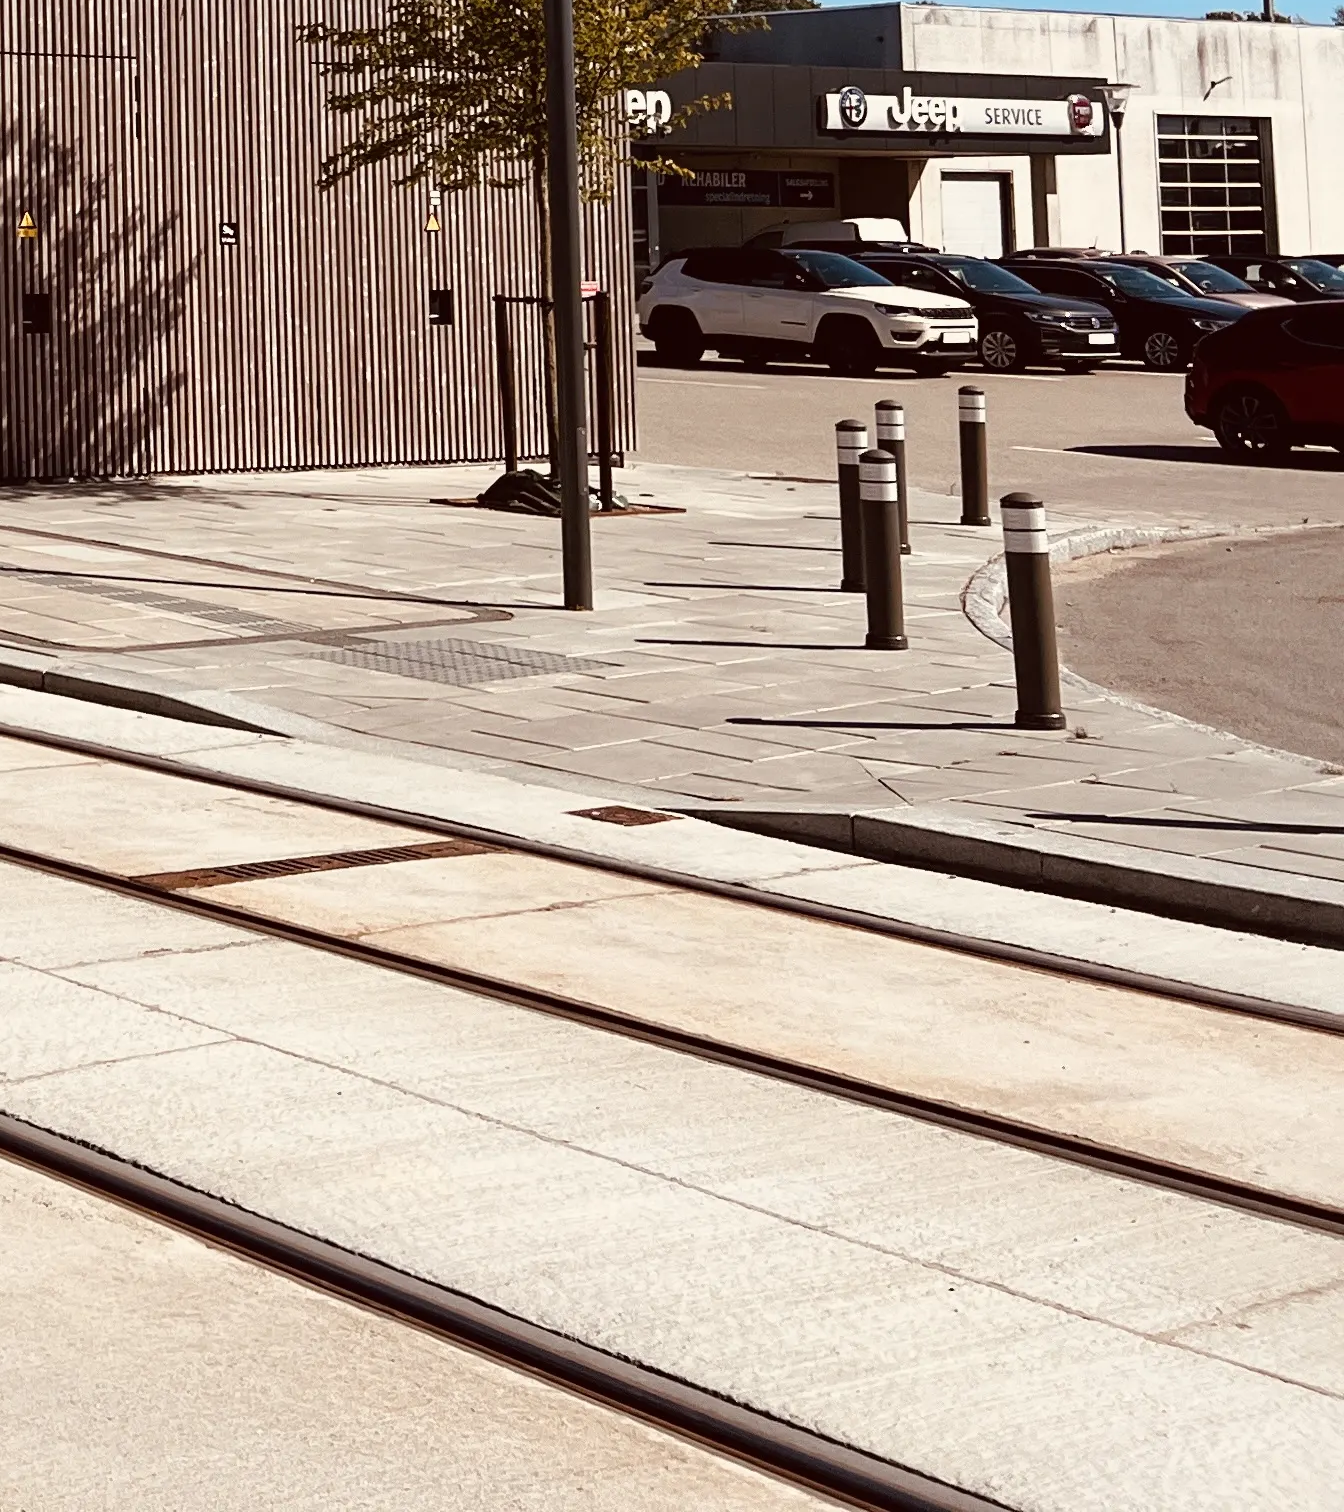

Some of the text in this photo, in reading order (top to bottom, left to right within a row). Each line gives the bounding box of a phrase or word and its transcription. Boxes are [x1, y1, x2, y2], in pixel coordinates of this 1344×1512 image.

[626, 88, 673, 135] ep
[889, 86, 965, 133] Jeep
[984, 107, 1043, 126] SERVICE
